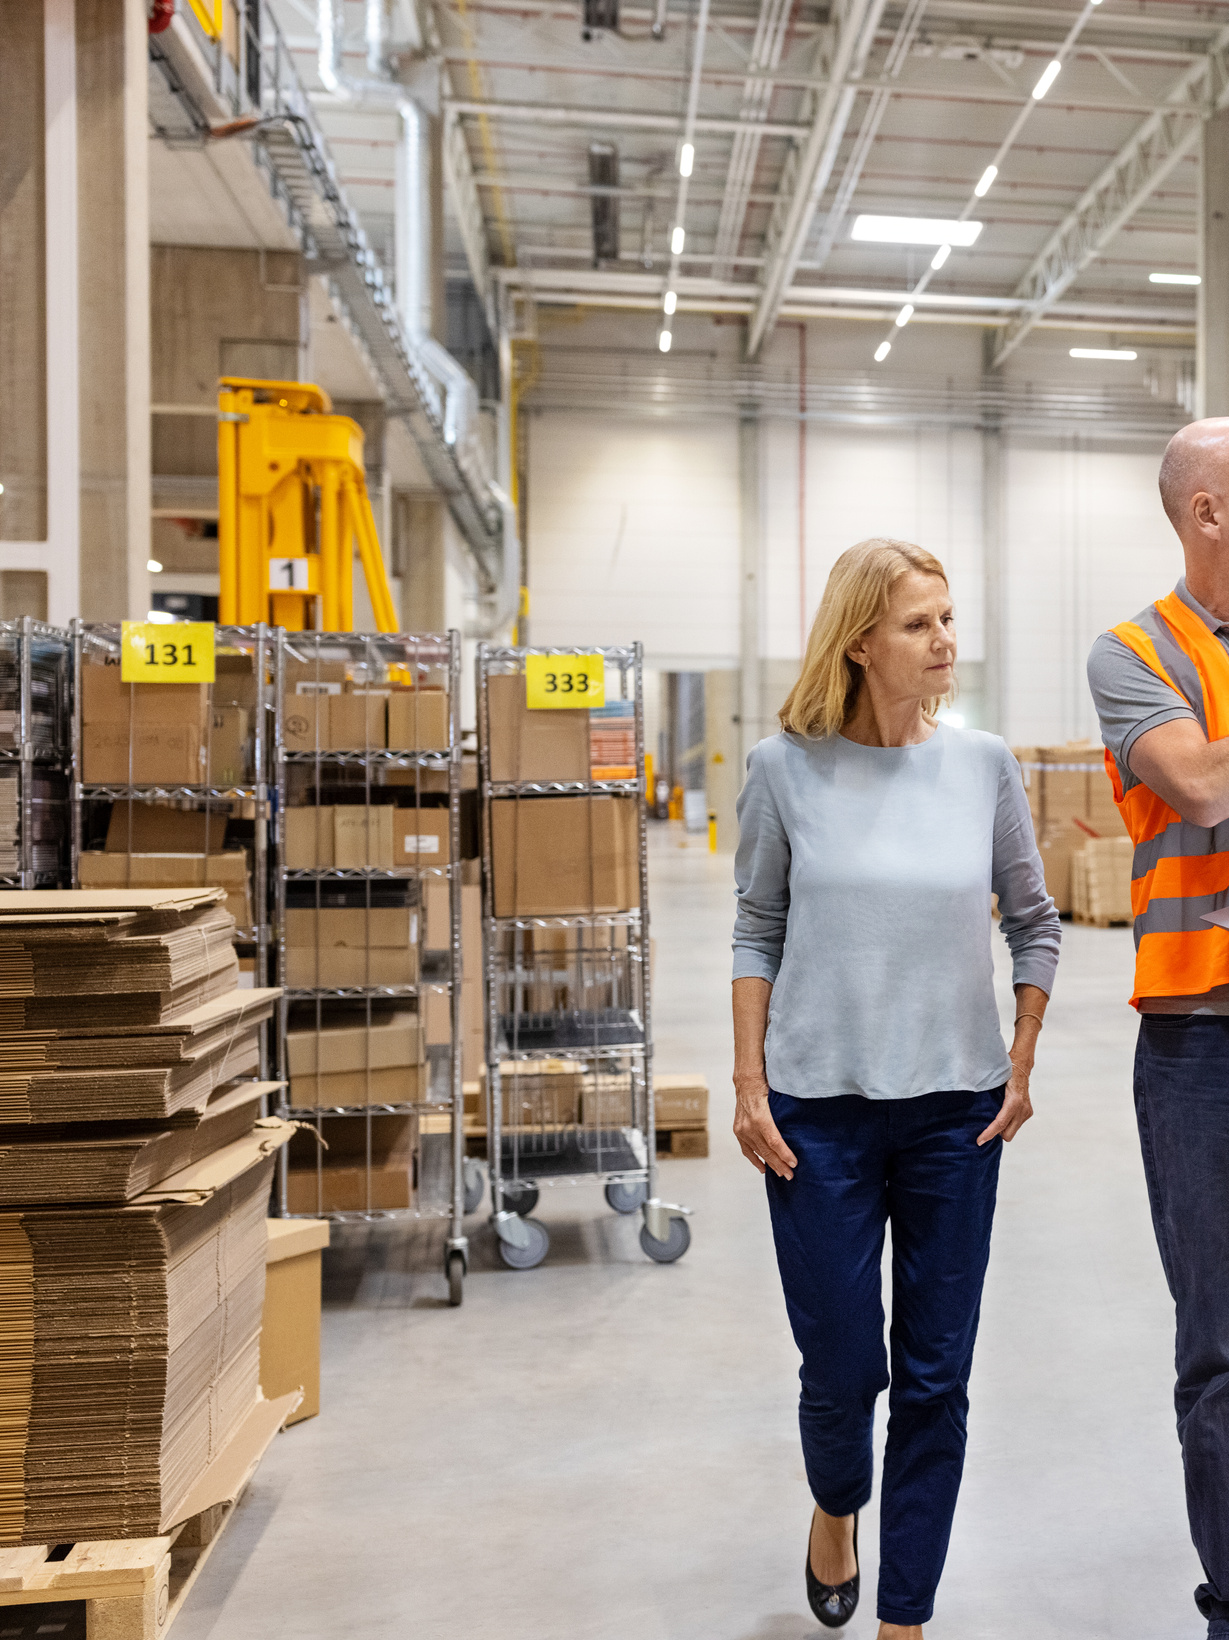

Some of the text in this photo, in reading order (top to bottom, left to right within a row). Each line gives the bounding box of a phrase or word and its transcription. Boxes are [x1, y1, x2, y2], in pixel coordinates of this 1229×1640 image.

[280, 561, 295, 588] 1
[144, 643, 197, 666] 131
[544, 672, 590, 693] 333
